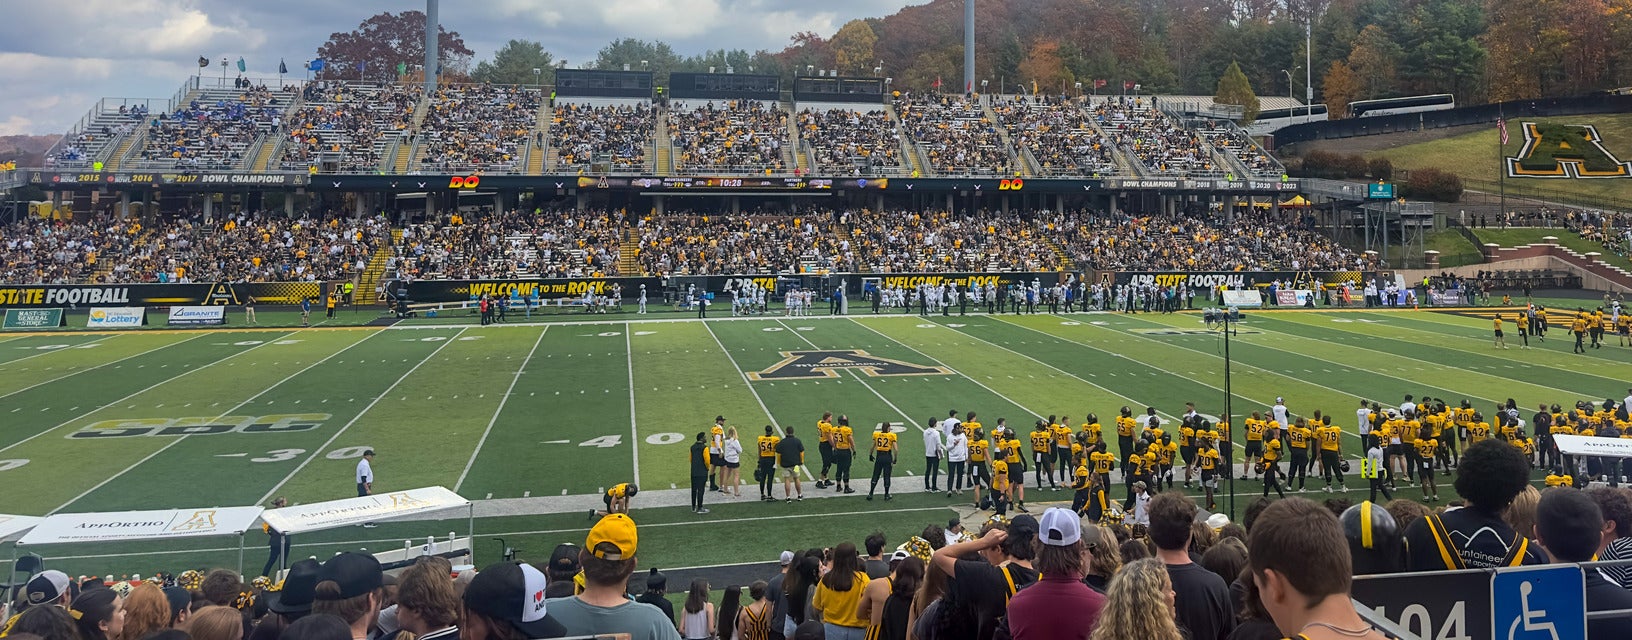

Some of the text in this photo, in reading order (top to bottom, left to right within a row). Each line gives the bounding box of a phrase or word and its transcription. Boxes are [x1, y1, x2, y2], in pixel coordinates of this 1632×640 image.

[78, 174, 100, 182] 2015
[132, 174, 153, 182] 2016
[176, 175, 198, 183] 2017
[202, 174, 228, 183] BOWL
[231, 174, 285, 183] CHAMPIONS
[449, 175, 479, 189] DO
[720, 179, 742, 187] 10:28
[999, 178, 1024, 190] DO
[1188, 274, 1245, 288] FOOTBALL
[469, 281, 607, 297] WELCOME TO THE ROCK
[45, 288, 130, 304] FOOTBALL
[105, 315, 140, 324] Lottery
[64, 413, 333, 440] SBC
[1251, 423, 1263, 433] 52
[1401, 425, 1411, 435] 77
[1291, 432, 1303, 442] 58
[1324, 432, 1337, 442] 78
[1472, 428, 1484, 437] 42
[761, 442, 773, 452] 54
[877, 437, 889, 447] 62
[1033, 437, 1044, 447] 25
[970, 445, 981, 455] 56
[1421, 445, 1433, 454] 27
[1098, 460, 1107, 469] 16
